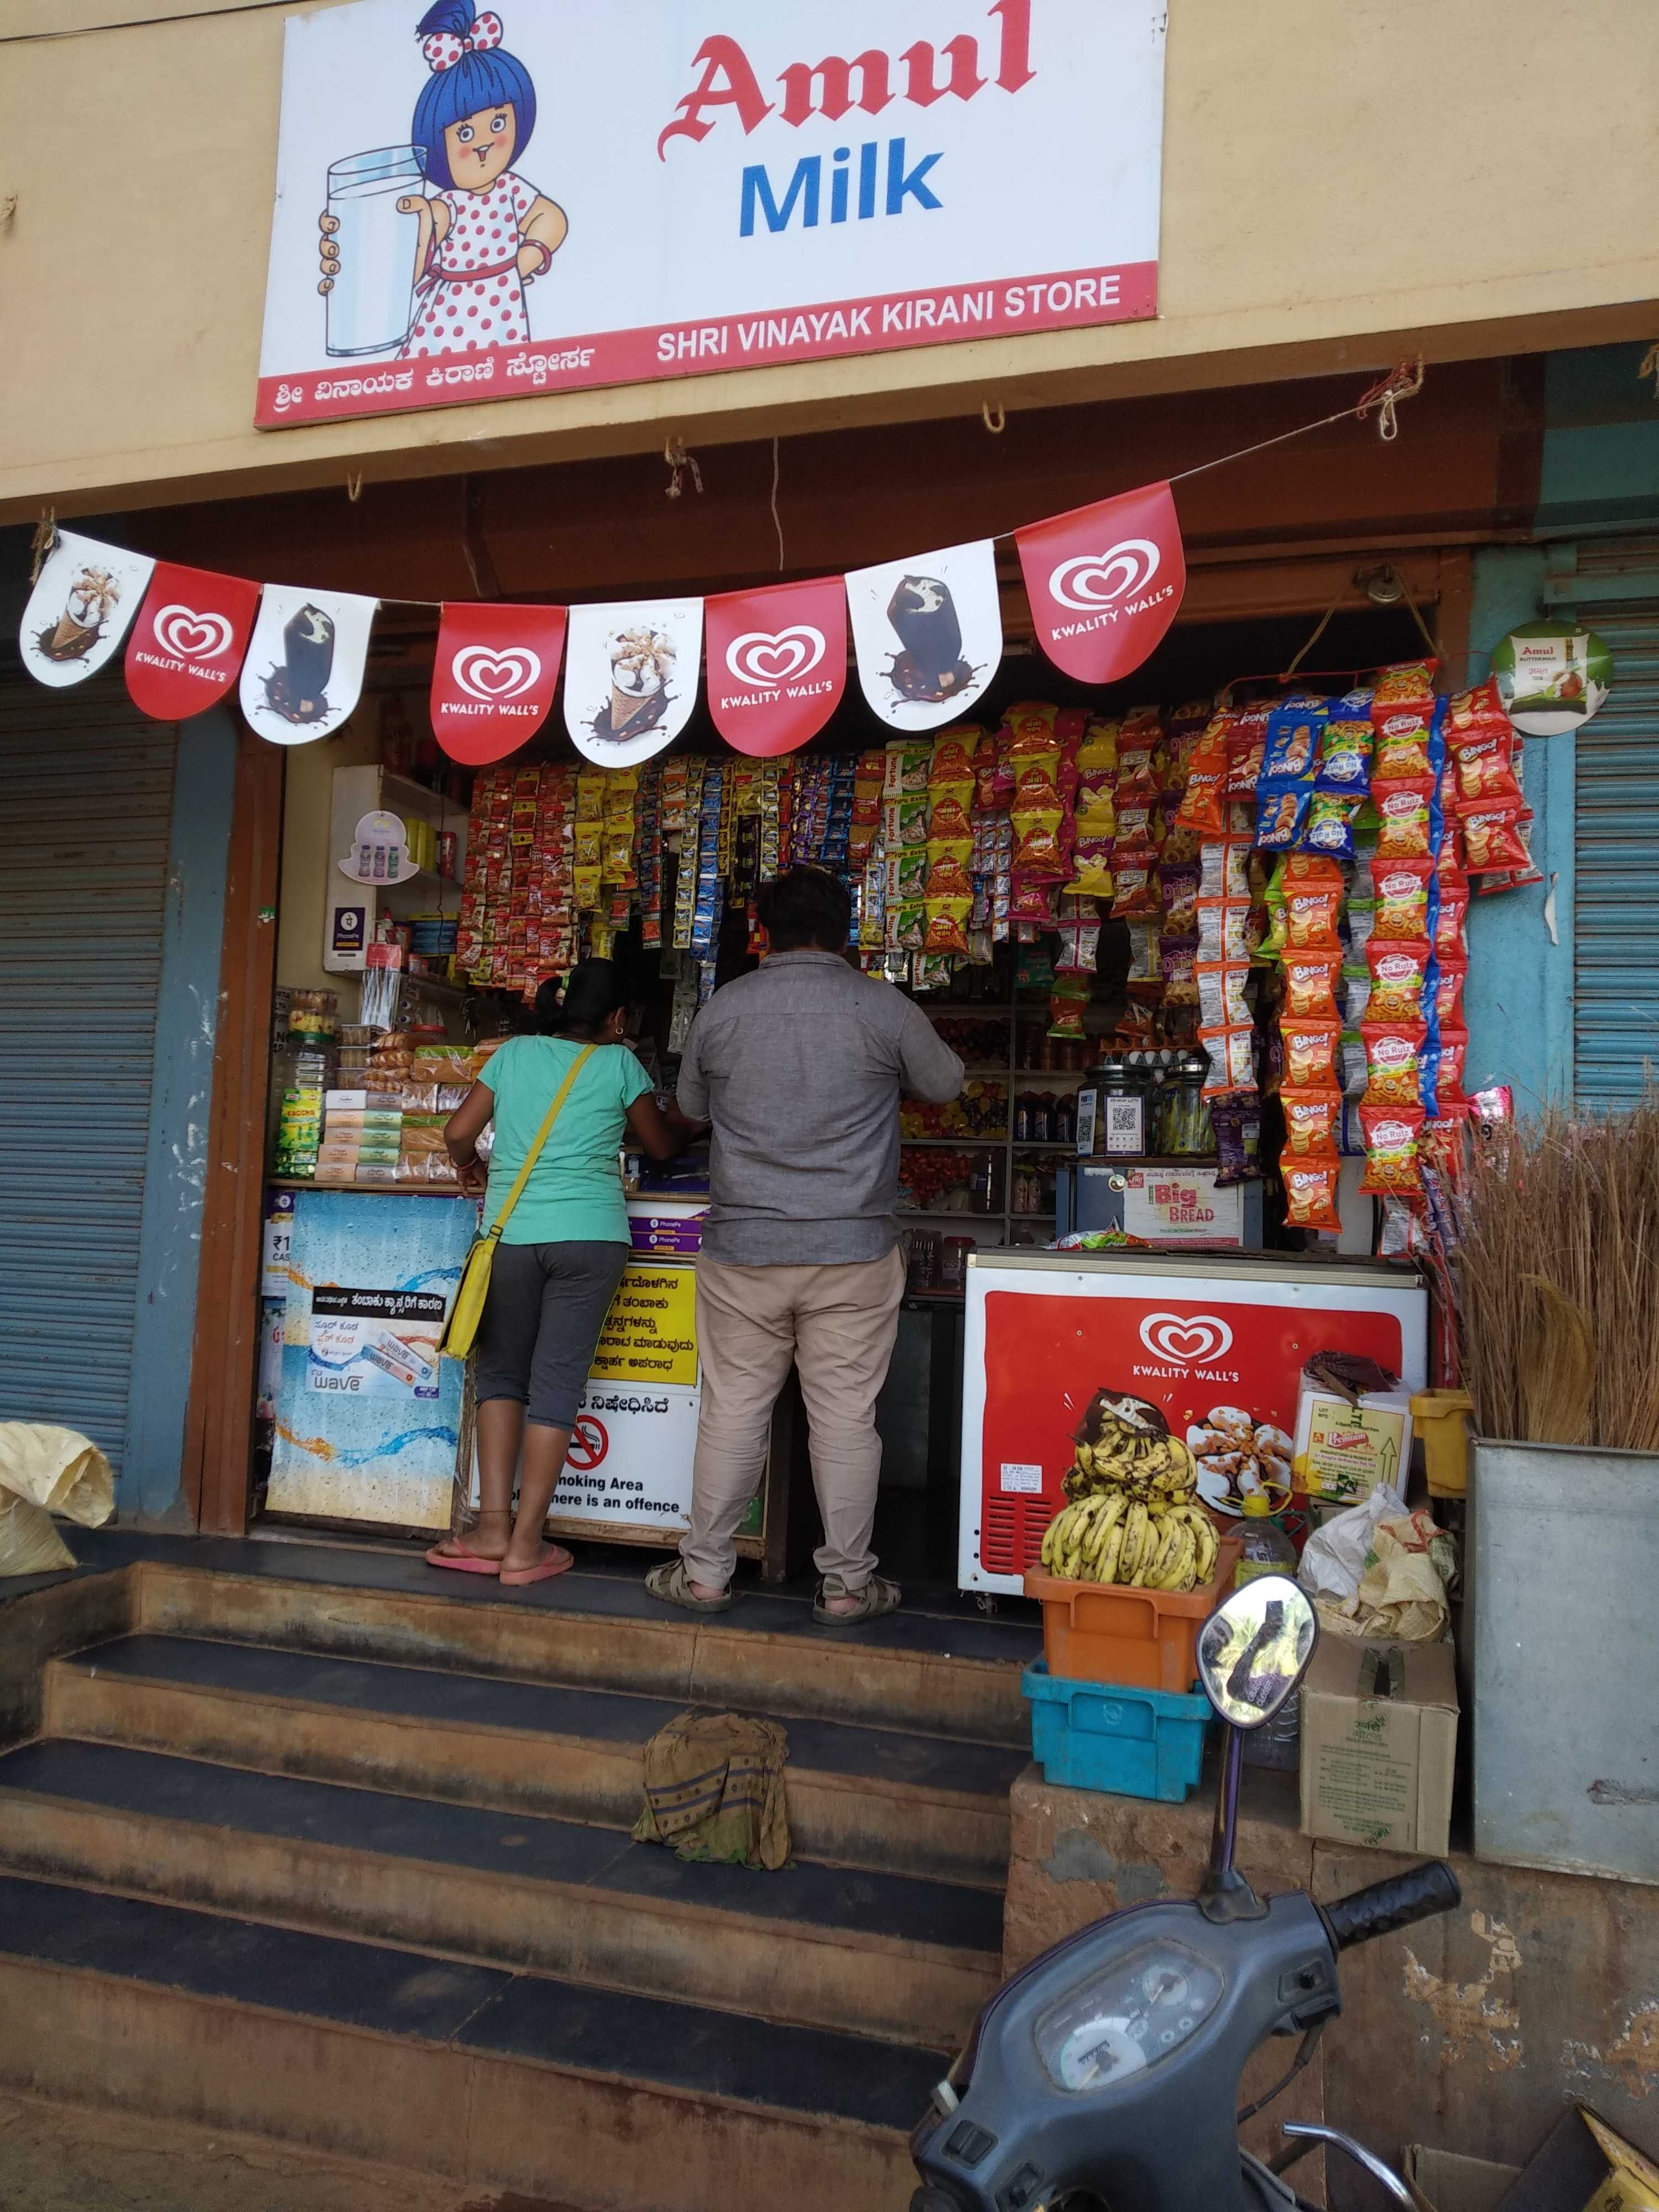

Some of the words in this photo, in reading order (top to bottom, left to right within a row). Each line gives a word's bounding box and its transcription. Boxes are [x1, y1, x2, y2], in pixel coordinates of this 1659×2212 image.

[658, 0, 1037, 162] Amul
[740, 137, 945, 238] Milk
[658, 326, 728, 361] SHRI
[738, 306, 873, 352] VINAYAK
[882, 291, 994, 333] KIRANI
[1004, 274, 1121, 319] STORE
[273, 384, 302, 412] ಶ್ರೀ
[314, 368, 414, 401] ವಿನಾಯಕ
[426, 357, 494, 387] ಕಿರಾಣಿ
[1052, 609, 1119, 641] KWALITY
[1125, 585, 1174, 617] WALL'S
[1521, 646, 1554, 655] Amul
[134, 651, 185, 676] KWALITY
[186, 661, 227, 683] WALL'S
[721, 690, 781, 709] KWALITY
[786, 680, 833, 698] WALL'S
[441, 702, 495, 716] KWALITY
[499, 703, 539, 716] WALL'S
[1401, 718, 1420, 728] Rulz
[1461, 738, 1499, 758] BINGO!
[1123, 755, 1147, 765] 65
[1268, 758, 1303, 775] BINGO!
[888, 757, 897, 788] Fortune
[1084, 766, 1115, 780] BINGO!
[1188, 773, 1222, 786] BINGO!
[1401, 796, 1420, 807] Rulz
[1120, 813, 1146, 824] 65
[1468, 810, 1506, 828] BINGO!
[1079, 834, 1109, 849] BINGO!
[1119, 874, 1145, 884] 65
[1385, 880, 1397, 889] No
[1399, 878, 1417, 887] Rulz
[1293, 894, 1328, 910] BINGO!
[1293, 964, 1328, 980] BINGO!
[1394, 961, 1413, 971] Rulz
[1293, 1033, 1328, 1049] BINGO!
[1378, 1048, 1390, 1056] No
[1293, 1103, 1328, 1119] BINGO!
[1376, 1132, 1388, 1140] No
[1389, 1129, 1408, 1138] Rulz
[1293, 1171, 1328, 1188] BINGO!
[1155, 1182, 1197, 1208] Big
[1170, 1206, 1214, 1222] BREAD
[418, 1297, 442, 1310] ಕಾರಣ
[623, 1296, 669, 1310] ತಂಬಾಕು
[634, 1337, 694, 1353] ಮಾಡುವುದು
[629, 1357, 673, 1371] ಅಪರಾಧ
[1133, 1365, 1190, 1379] KWALITY
[1194, 1369, 1239, 1383] WALL'S
[591, 1395, 669, 1416] ನಿಷೇಧಿಸಿದೆ
[558, 1474, 606, 1490] moking
[611, 1478, 643, 1491] Area
[587, 1494, 598, 1507] is
[603, 1498, 620, 1509] an
[626, 1498, 680, 1512] offence
